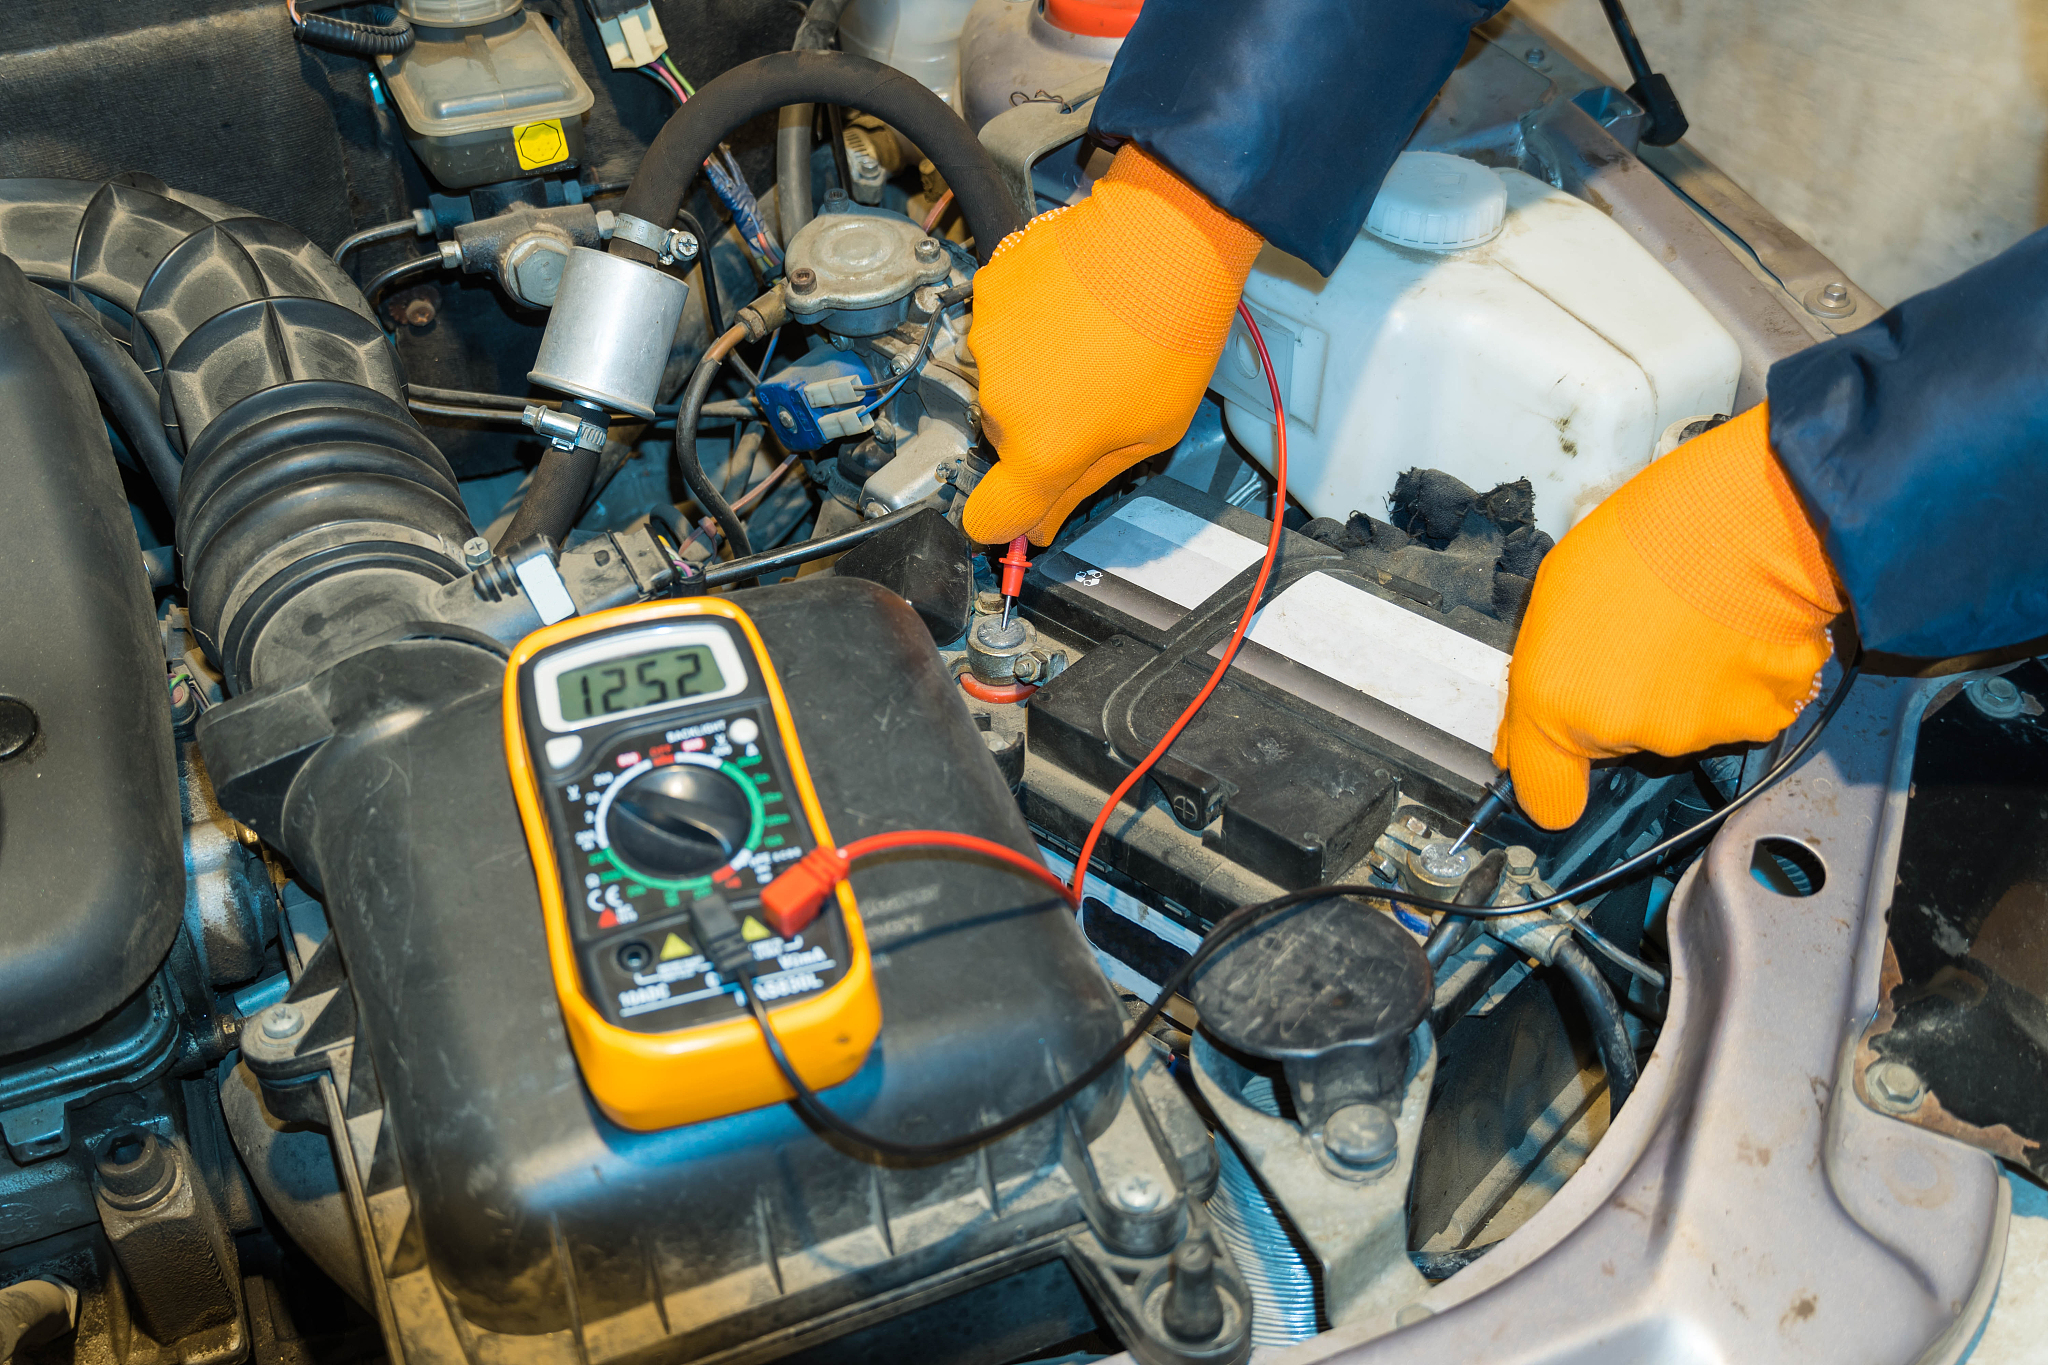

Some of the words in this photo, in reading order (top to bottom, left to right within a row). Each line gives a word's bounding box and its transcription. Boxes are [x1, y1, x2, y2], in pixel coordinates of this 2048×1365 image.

[666, 719, 726, 743] BACKLIGHT
[649, 744, 672, 756] OFF
[593, 771, 614, 787] 200
